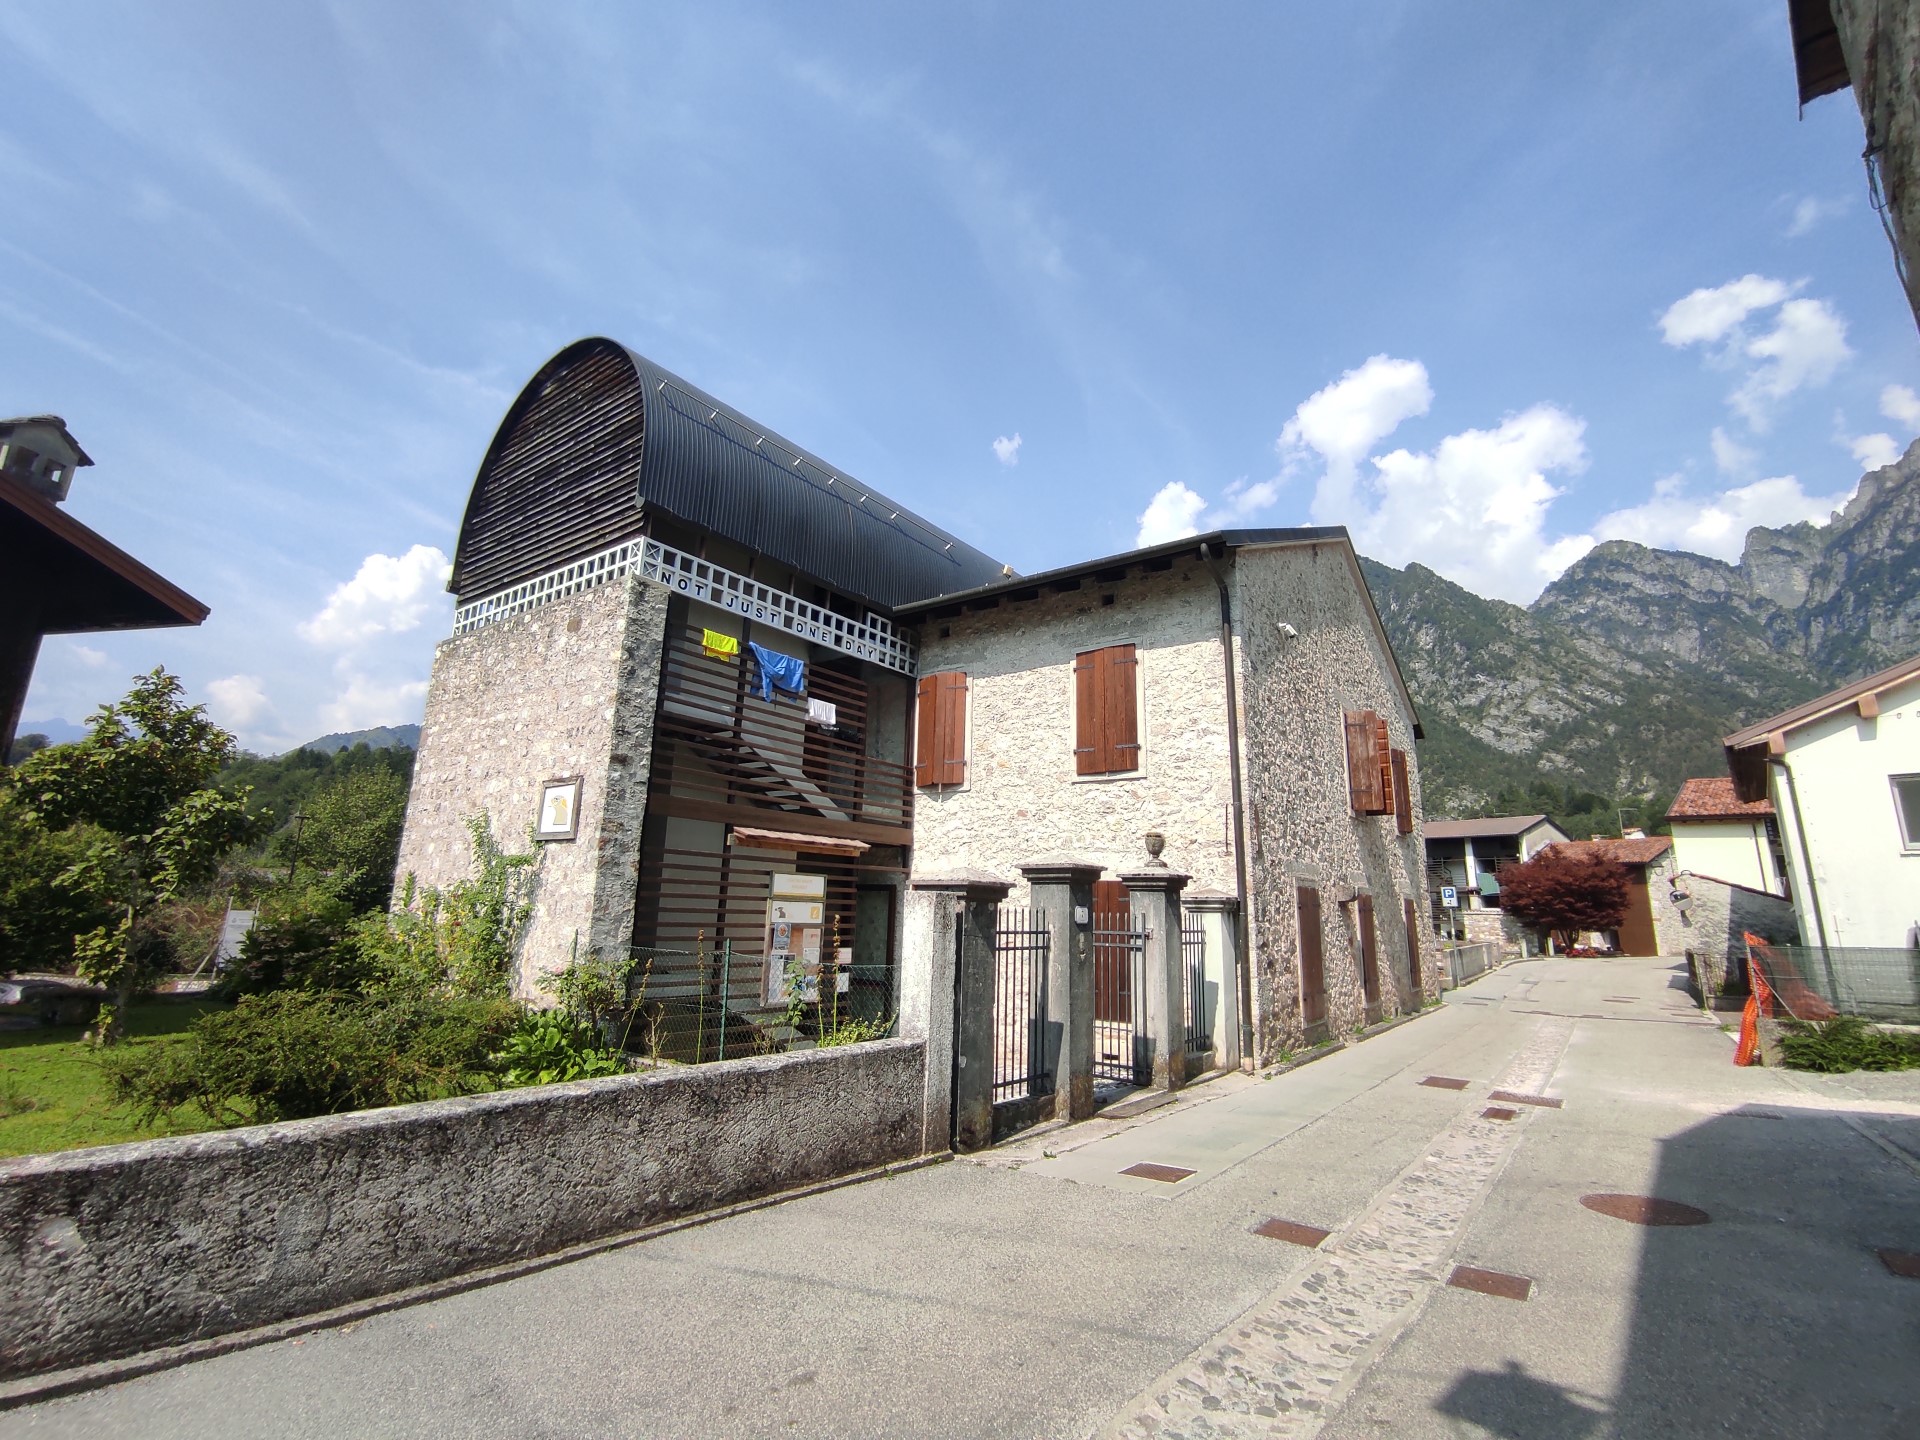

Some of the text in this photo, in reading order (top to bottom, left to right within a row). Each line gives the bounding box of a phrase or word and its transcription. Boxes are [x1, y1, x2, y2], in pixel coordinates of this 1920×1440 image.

[661, 571, 874, 659] NOT JUST ONE DAY
[1444, 889, 1453, 898] P
